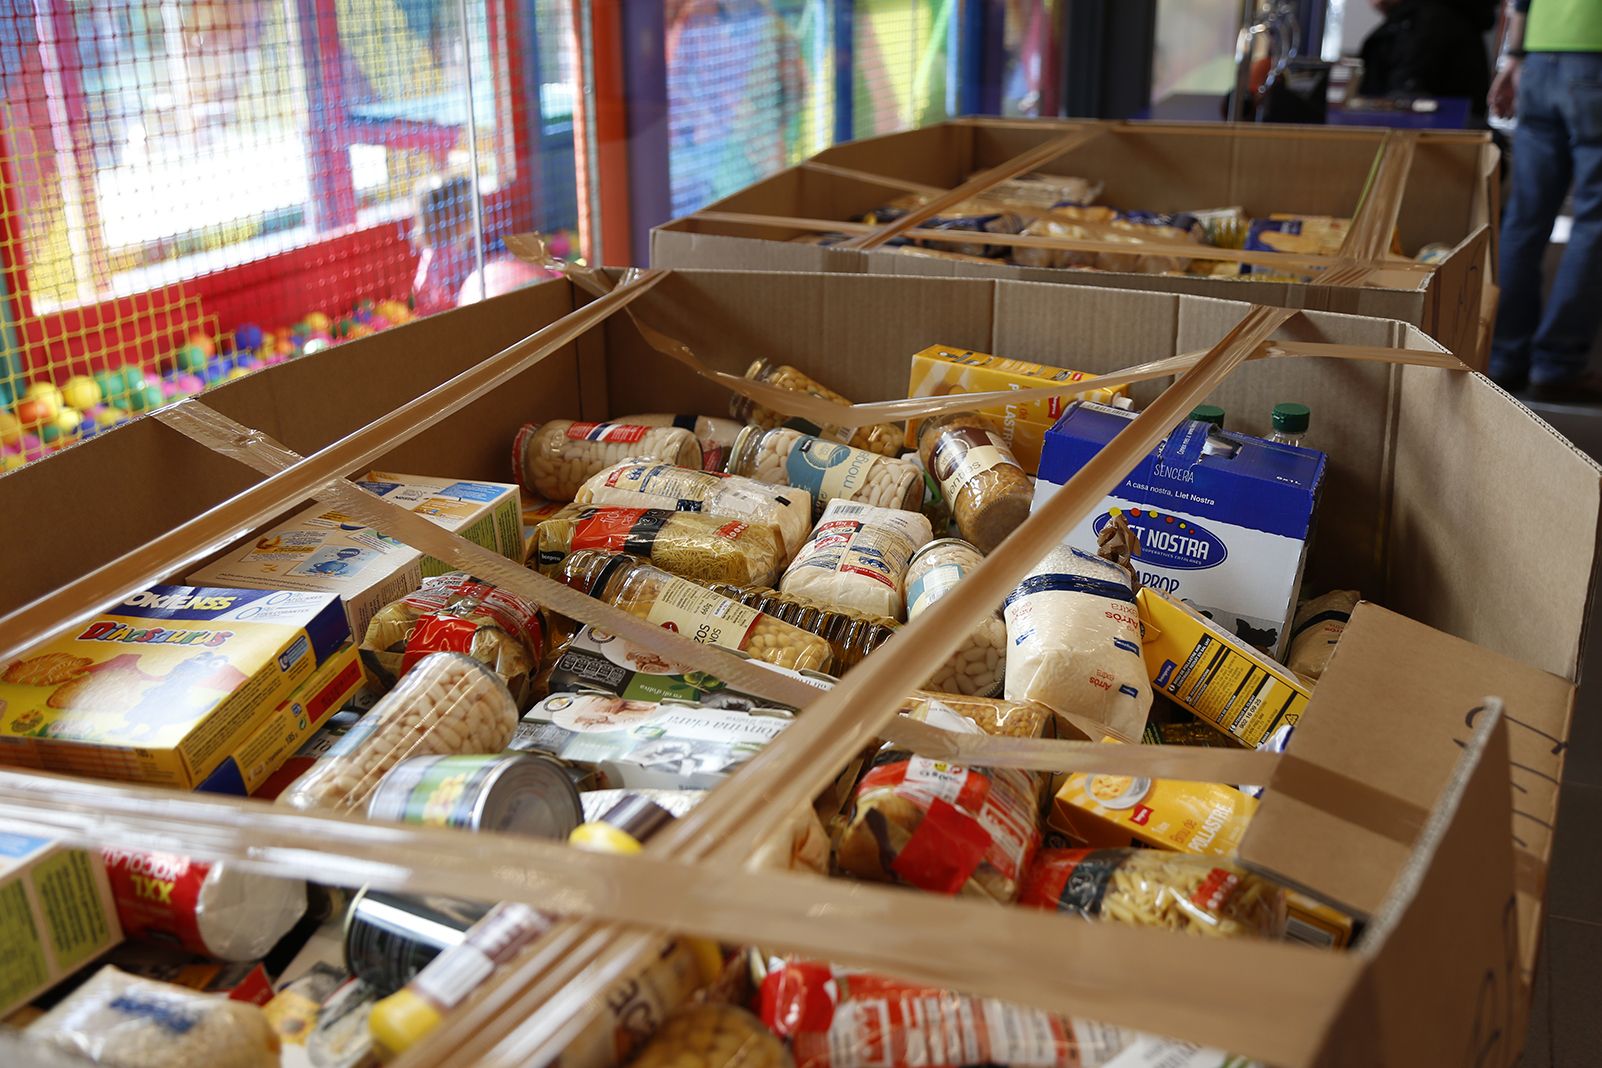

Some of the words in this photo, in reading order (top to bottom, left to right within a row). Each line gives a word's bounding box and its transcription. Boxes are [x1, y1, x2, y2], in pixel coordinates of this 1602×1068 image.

[1153, 464, 1194, 483] SENCERA
[1133, 482, 1149, 491] casa
[1150, 486, 1173, 497] nostra,
[1175, 491, 1190, 501] Llet
[1190, 493, 1215, 506] Nostra
[1147, 529, 1210, 560] NOSTRA
[1104, 611, 1139, 630] Arròs
[1089, 677, 1111, 691] Arròs
[1250, 705, 1257, 713] 09
[1254, 698, 1262, 706] 25
[1187, 801, 1233, 852] POLLASTRE
[131, 874, 175, 905] XXL
